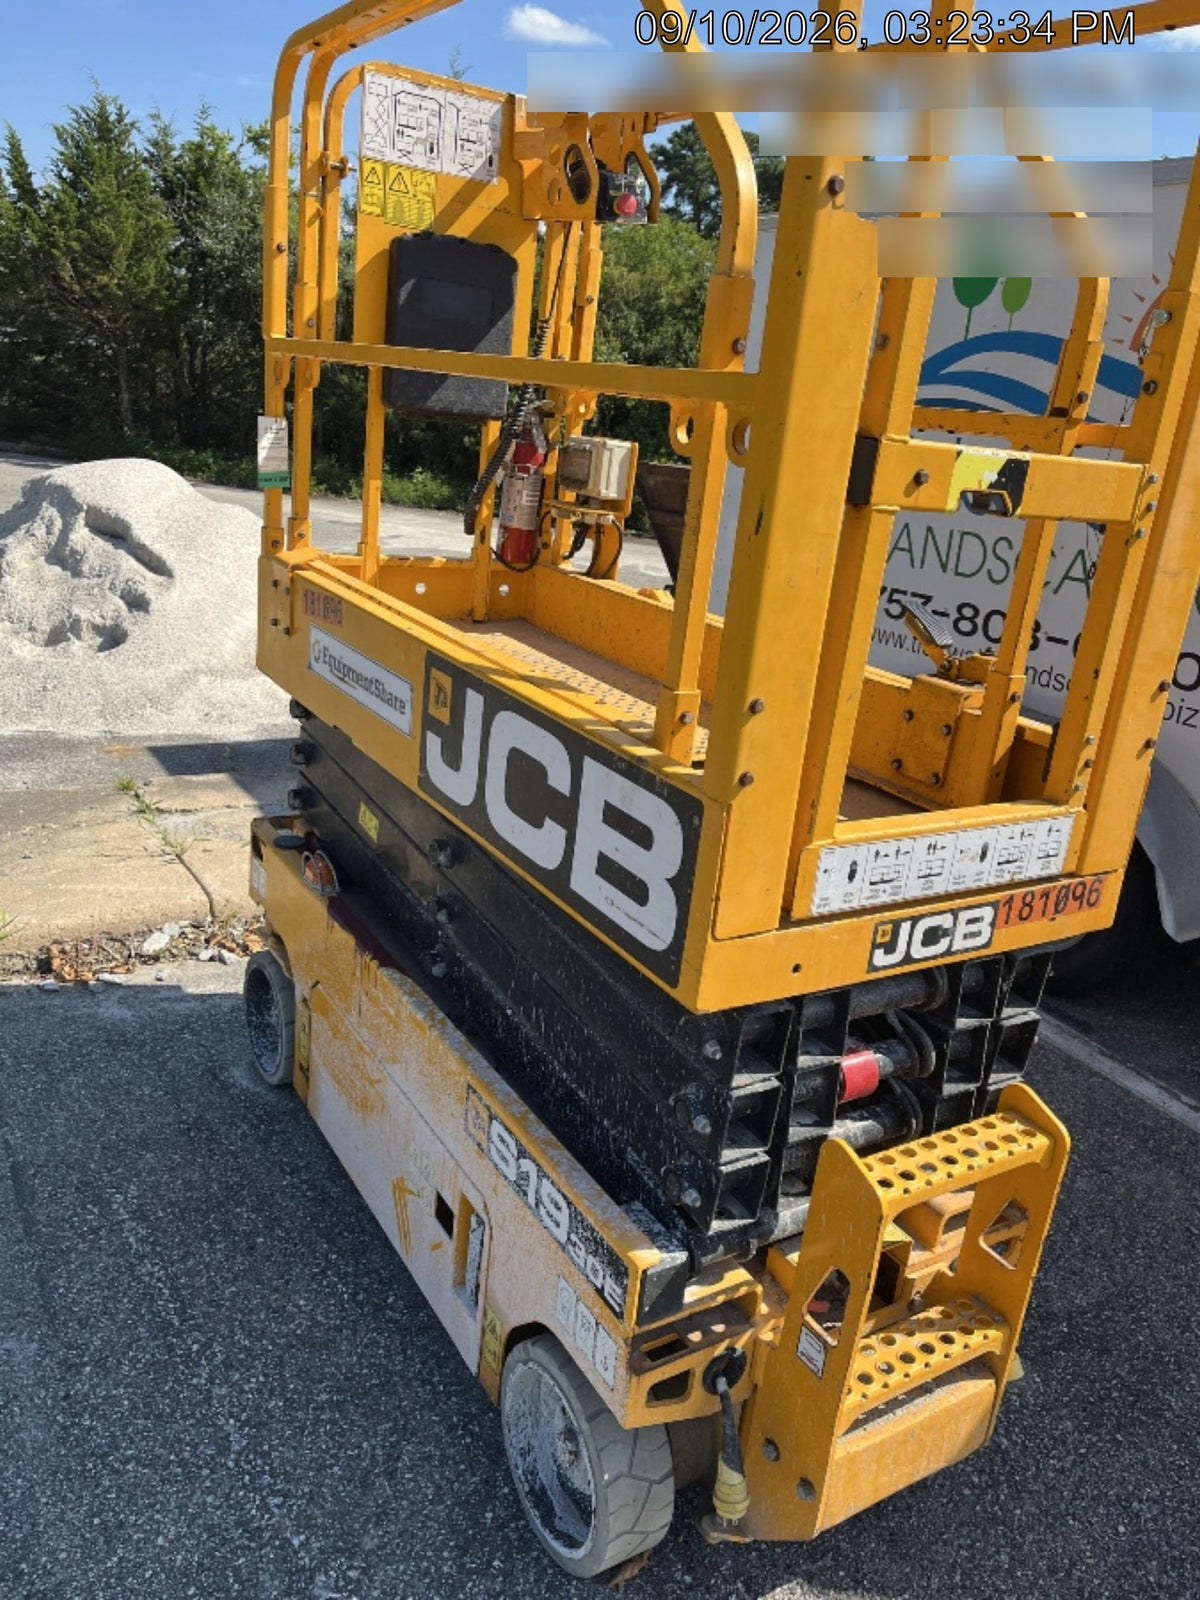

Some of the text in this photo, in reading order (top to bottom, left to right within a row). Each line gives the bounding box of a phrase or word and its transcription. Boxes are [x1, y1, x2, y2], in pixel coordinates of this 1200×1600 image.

[322, 643, 406, 715] EquipmentShare
[426, 687, 684, 951] JCB
[1001, 879, 1103, 925] 181096
[872, 906, 995, 967] JCB
